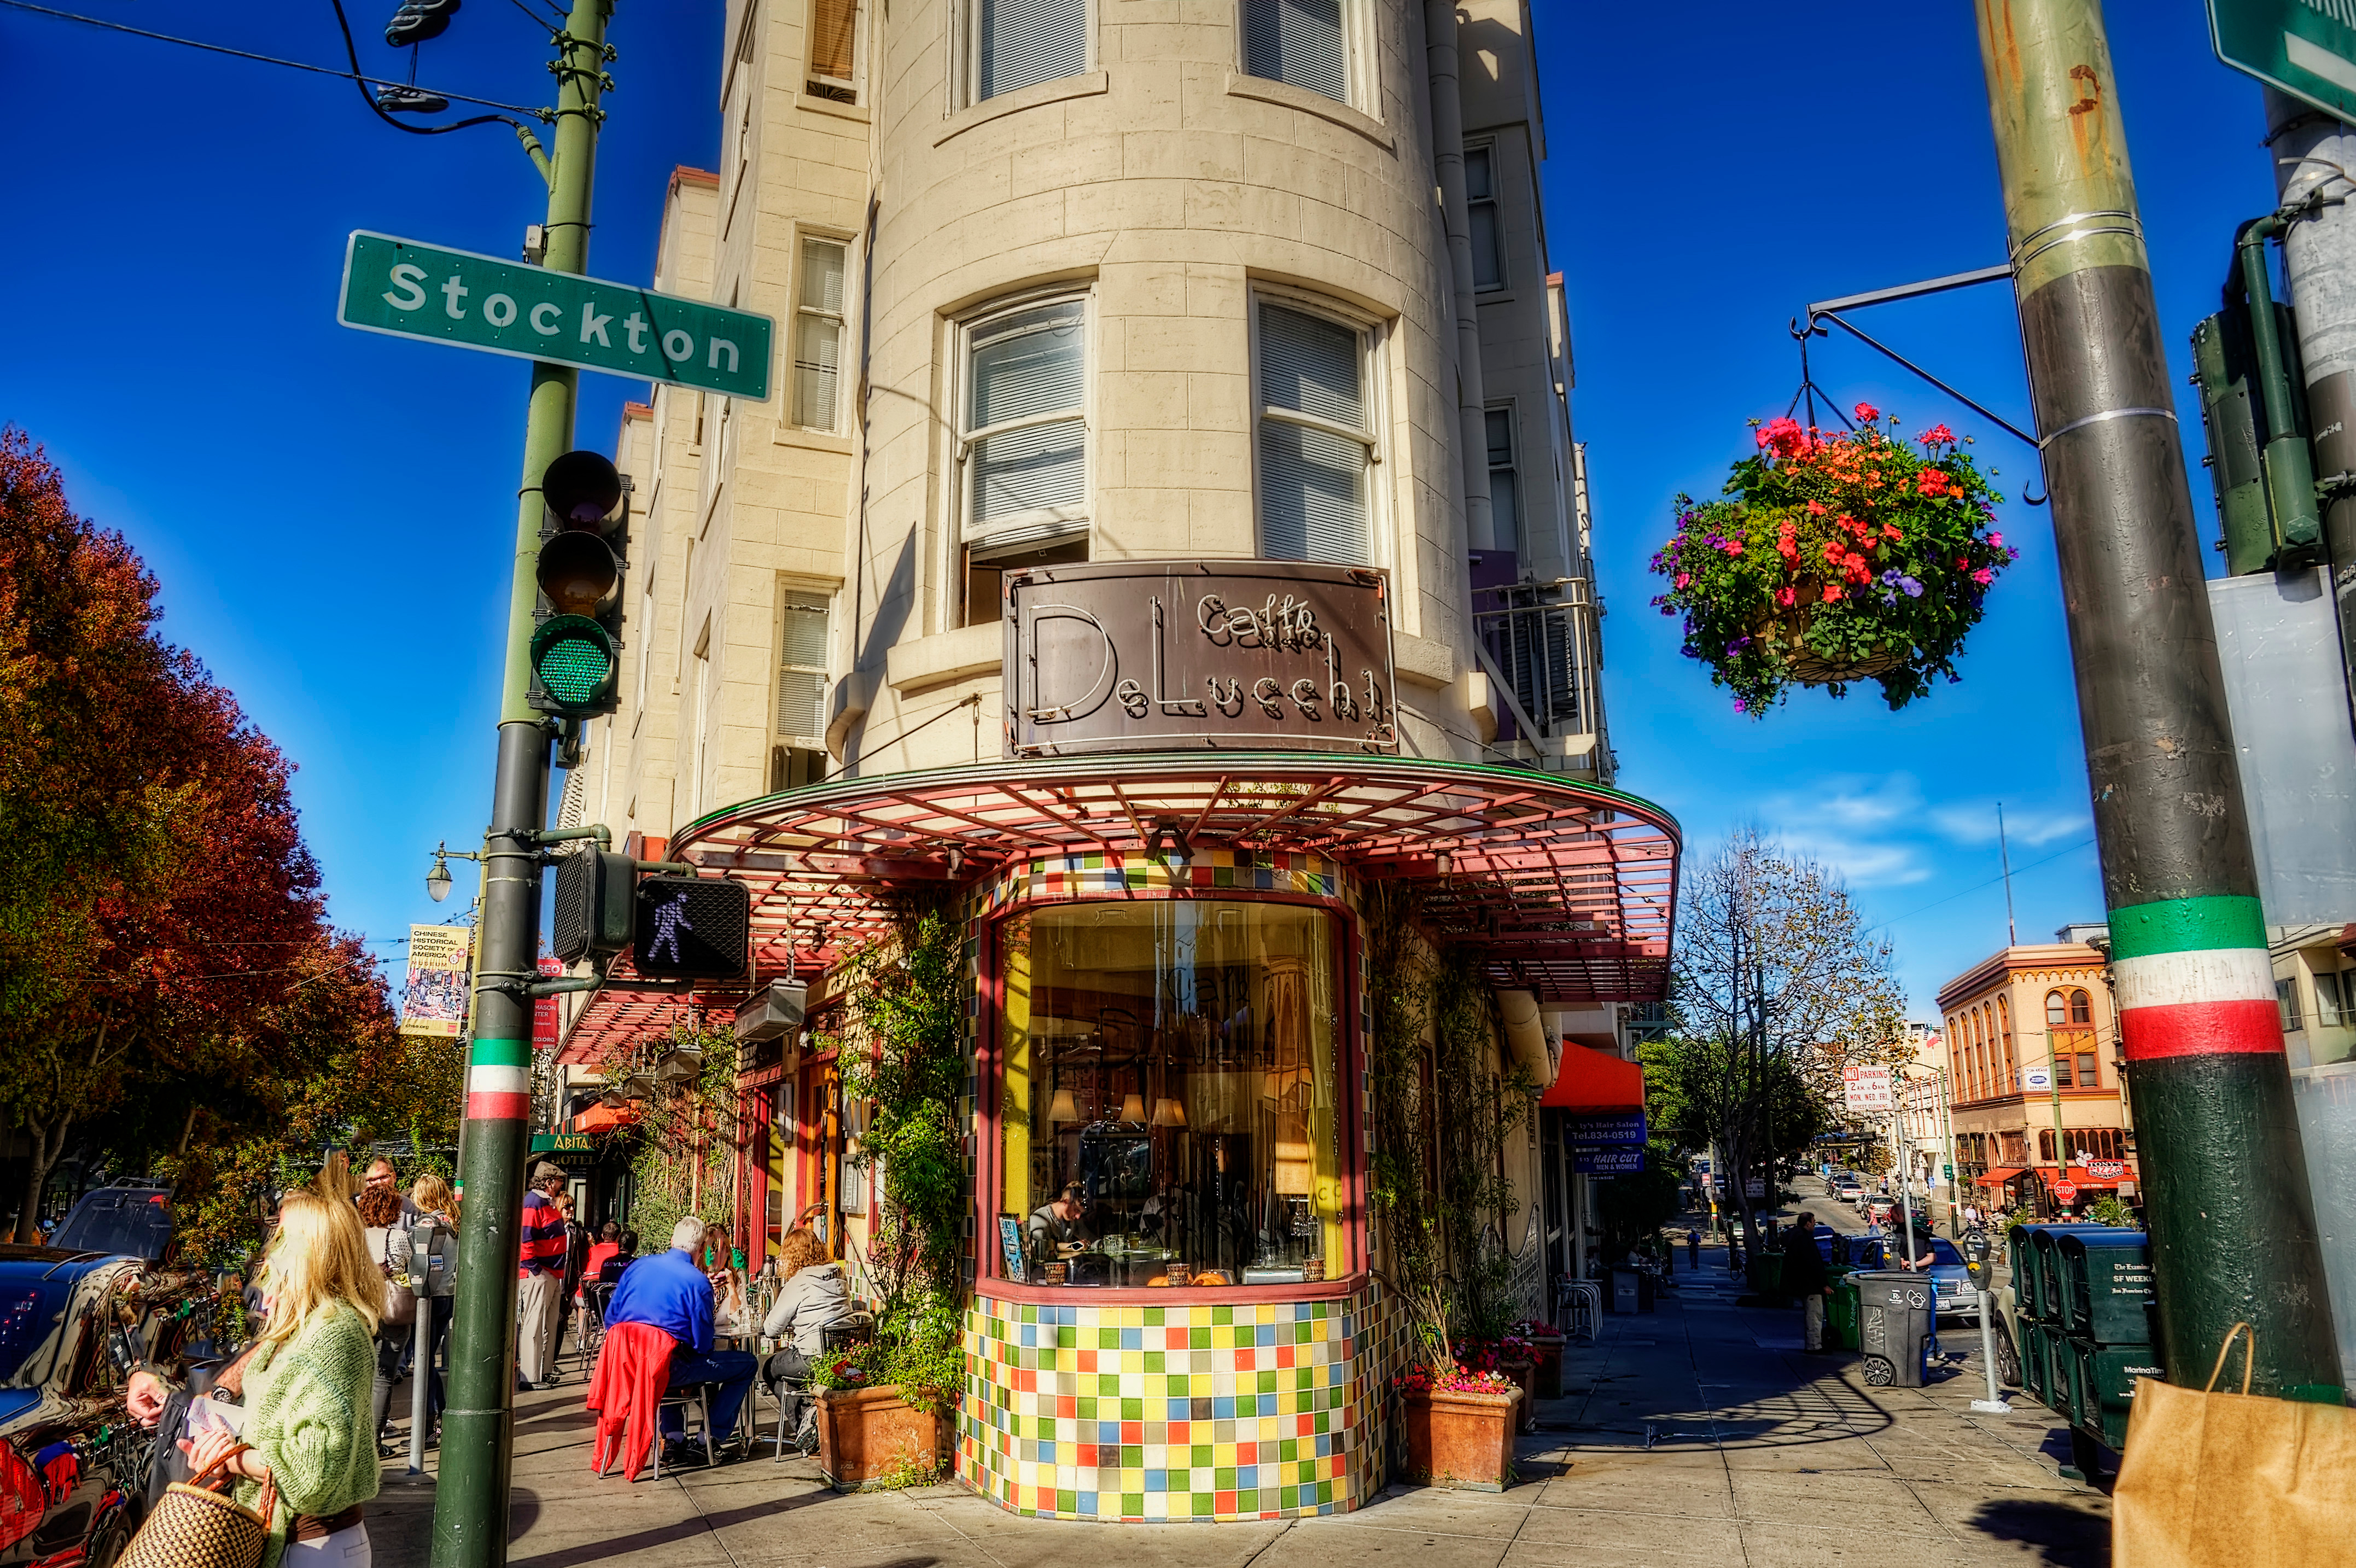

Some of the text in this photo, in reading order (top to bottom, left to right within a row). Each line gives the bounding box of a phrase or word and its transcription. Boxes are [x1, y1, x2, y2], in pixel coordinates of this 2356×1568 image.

[381, 263, 740, 374] Stockton
[1845, 1068, 1888, 1080] NO PARKING
[1851, 1082, 1856, 1091] 2
[1593, 1154, 1640, 1163] HAIR CUT
